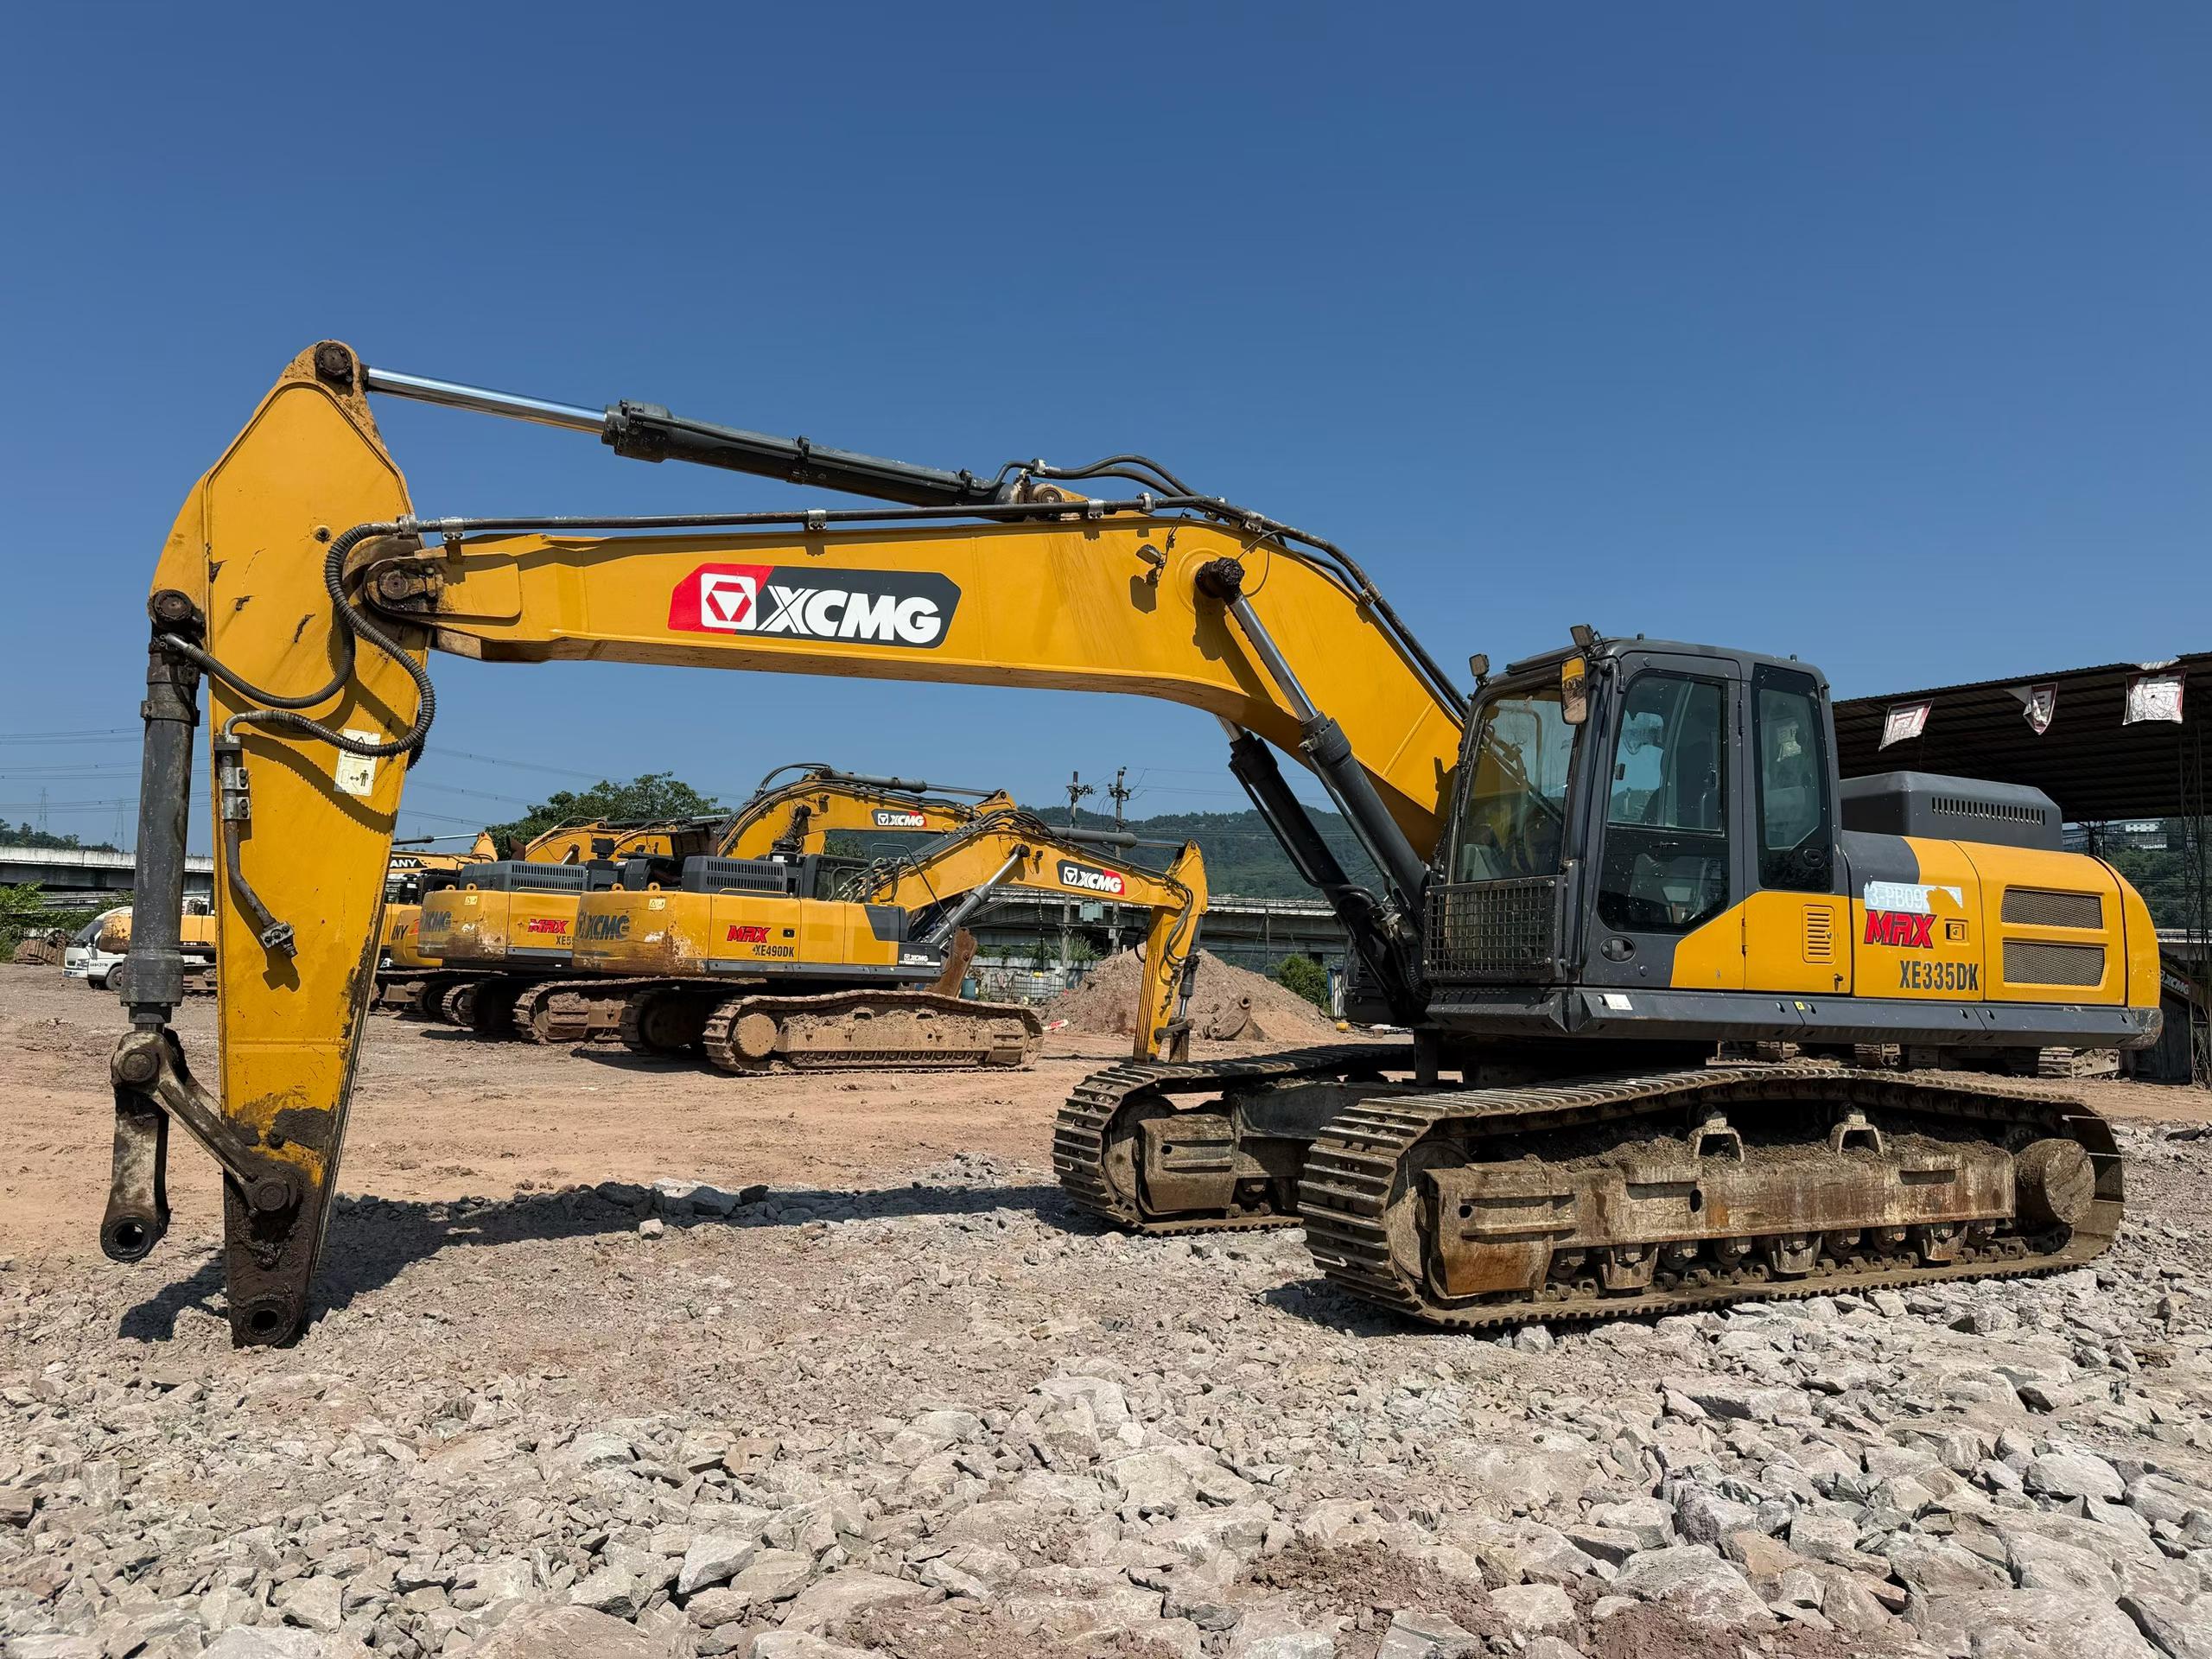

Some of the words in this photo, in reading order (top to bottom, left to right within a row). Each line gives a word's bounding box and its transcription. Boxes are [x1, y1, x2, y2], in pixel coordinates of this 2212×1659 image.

[756, 585, 941, 644] XCMG
[888, 814, 925, 827] XCMG
[390, 859, 417, 868] ANY
[1077, 871, 1122, 893] XCMG
[527, 918, 569, 934] MAX
[727, 925, 772, 944] MAX
[1864, 909, 1937, 949] MAX
[556, 936, 574, 946] XE5
[754, 944, 795, 957] XE490DK
[1899, 960, 1979, 991] XE335DK
